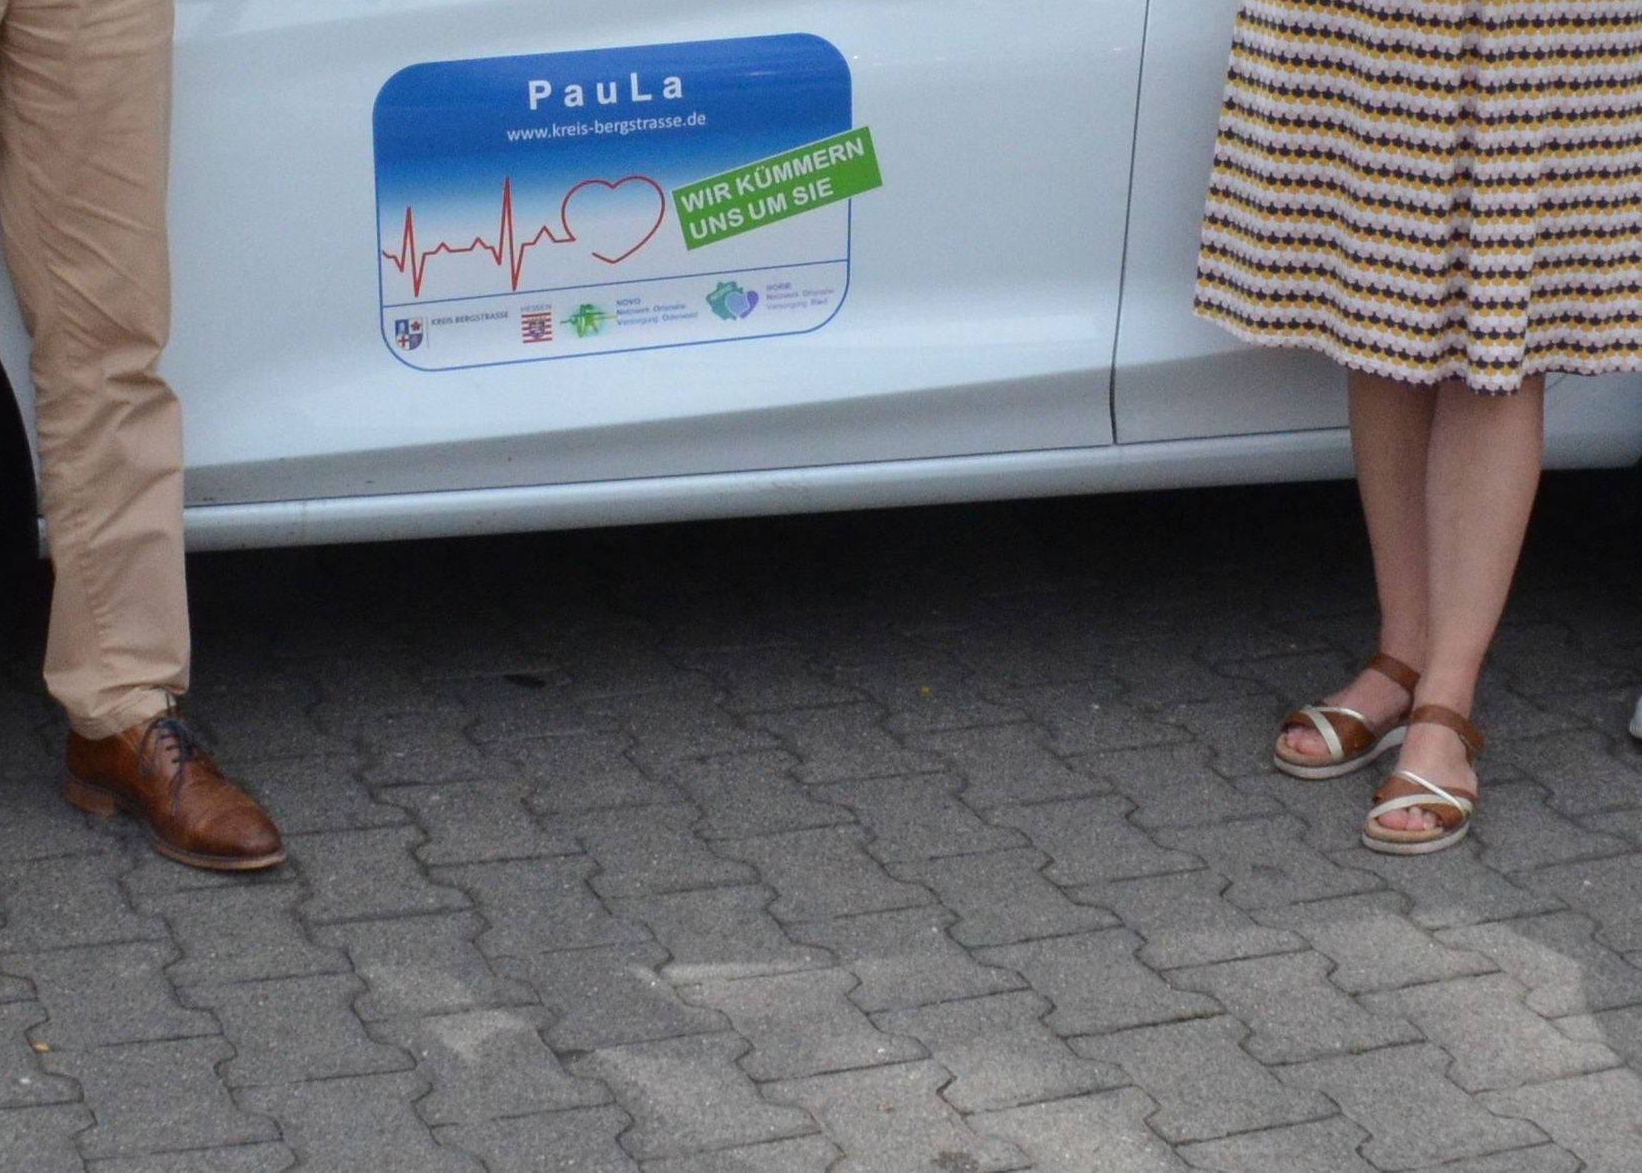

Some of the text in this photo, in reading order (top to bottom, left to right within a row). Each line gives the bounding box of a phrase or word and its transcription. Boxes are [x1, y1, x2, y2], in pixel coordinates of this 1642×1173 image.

[528, 72, 683, 110] PauLa
[507, 111, 706, 141] www.kreis-bergstrasse.de
[681, 136, 864, 213] WIR KÜMMERN
[689, 177, 834, 240] UNS UM SIE
[431, 310, 509, 326] KREIS BERGSTRASSE
